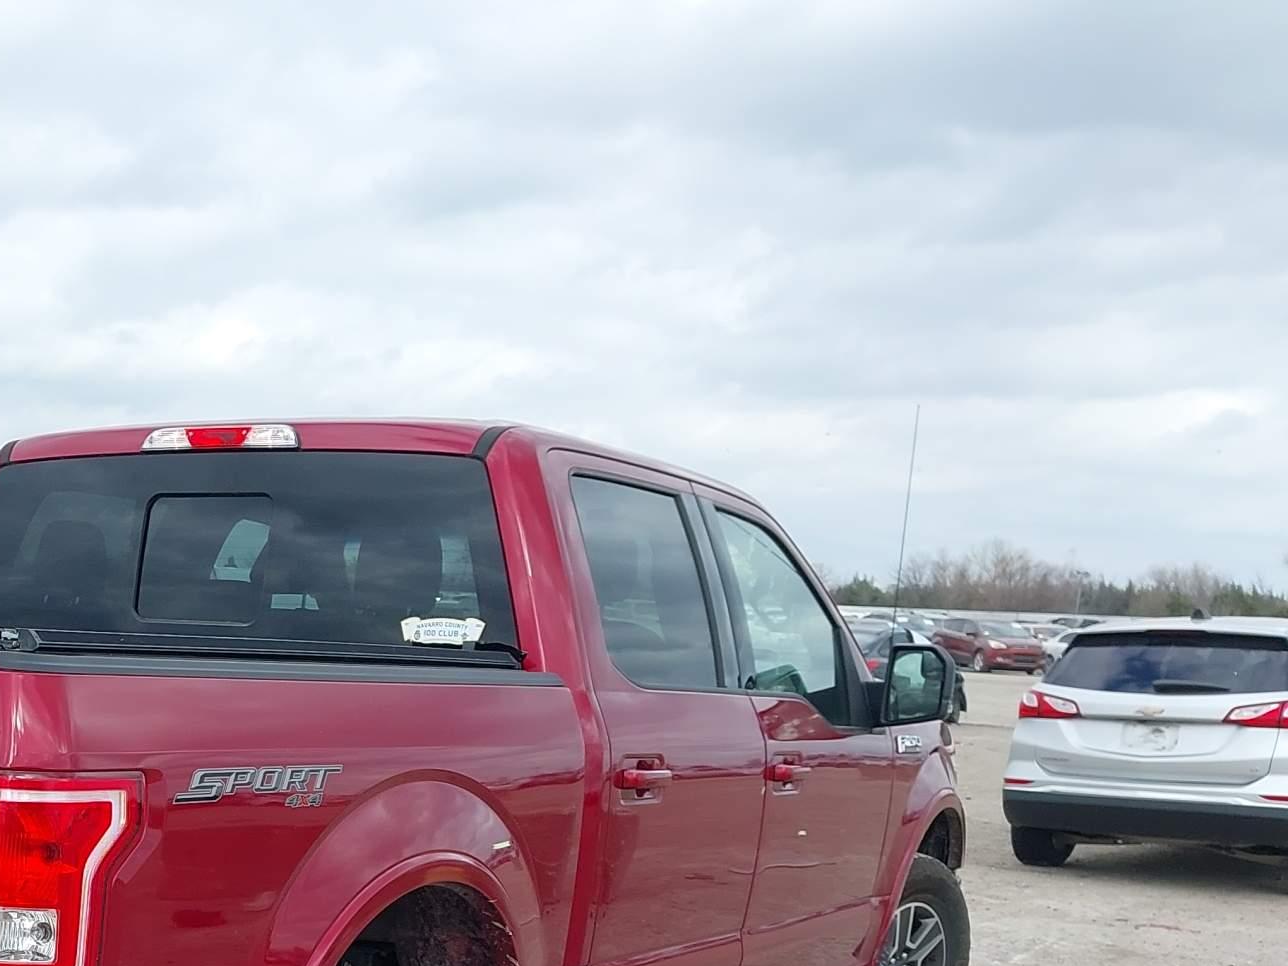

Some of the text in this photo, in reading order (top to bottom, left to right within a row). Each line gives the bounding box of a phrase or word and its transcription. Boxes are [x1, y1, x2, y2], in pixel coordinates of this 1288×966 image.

[445, 621, 468, 629] COUNTY
[438, 629, 459, 637] CLUB
[173, 764, 344, 805] SPORT
